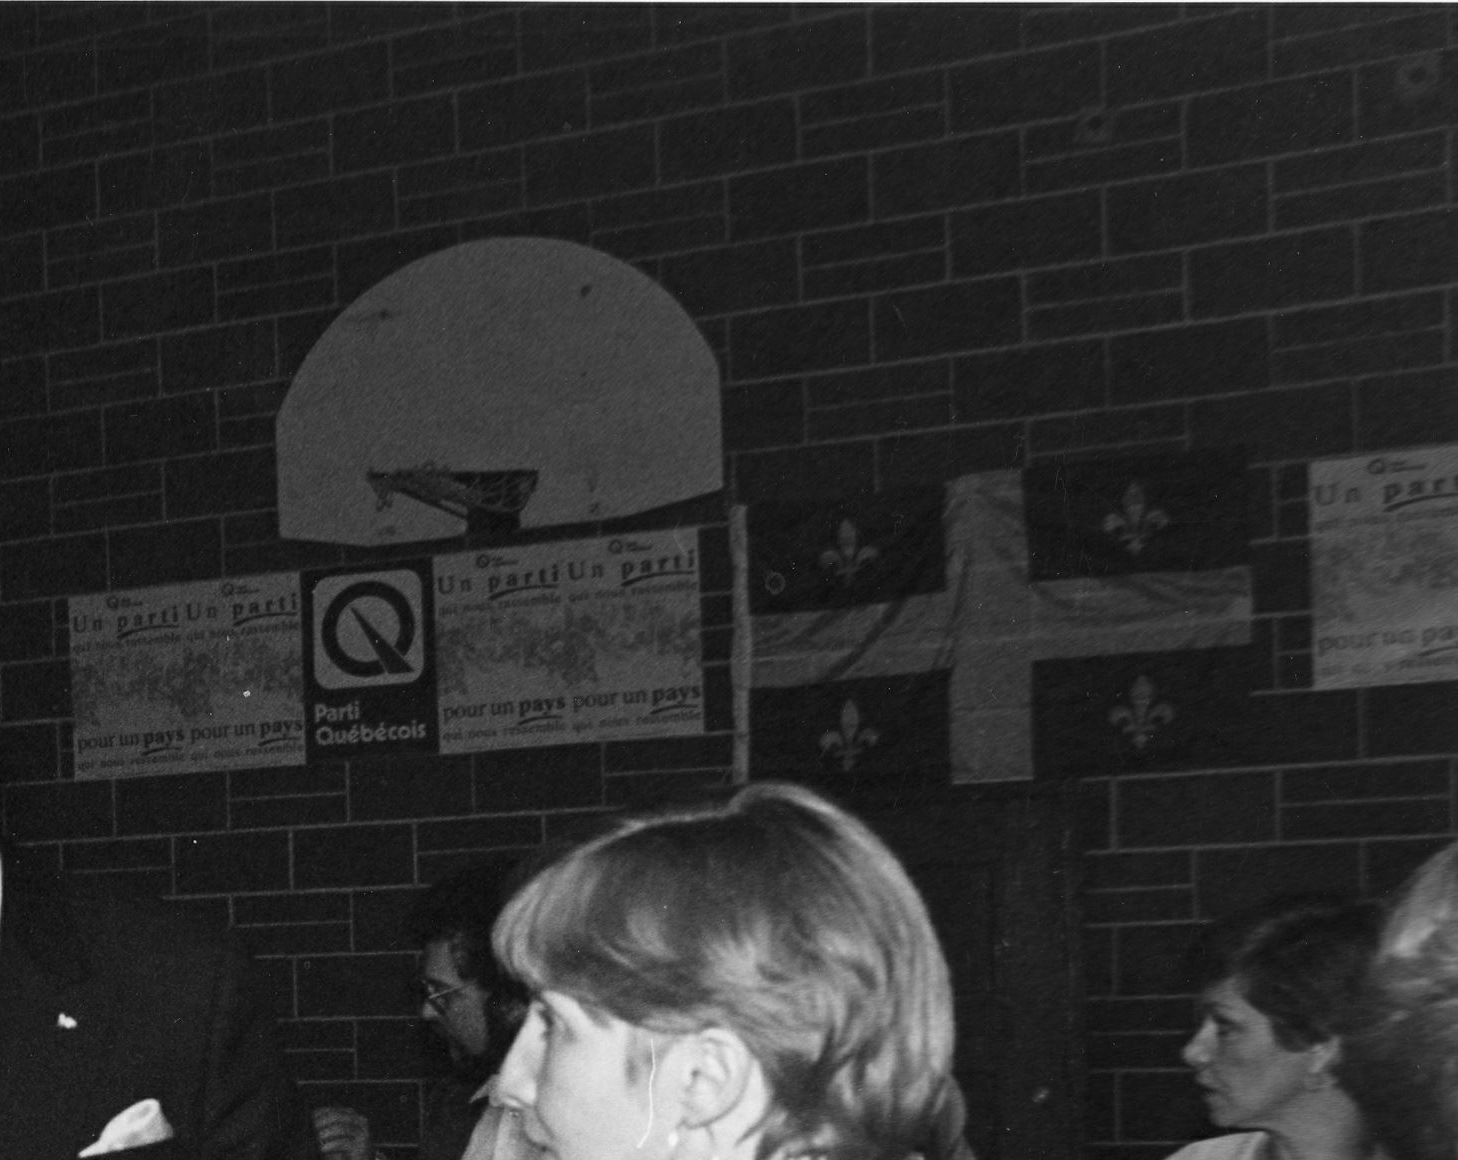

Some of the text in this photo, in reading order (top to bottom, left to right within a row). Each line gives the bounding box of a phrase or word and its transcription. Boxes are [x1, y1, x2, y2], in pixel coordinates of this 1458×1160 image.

[1312, 481, 1361, 506] Un
[437, 563, 560, 594] Un parti
[567, 549, 695, 581] Un parti
[73, 605, 179, 633] Un parti
[186, 592, 298, 621] Un parti
[1421, 625, 1458, 648] pa
[314, 699, 360, 723] Parti
[442, 695, 567, 725] pour un pays
[572, 685, 701, 713] pour un pays
[77, 728, 185, 753] pour un pays
[190, 720, 303, 744] pour un pays
[315, 719, 426, 746] Québécois
